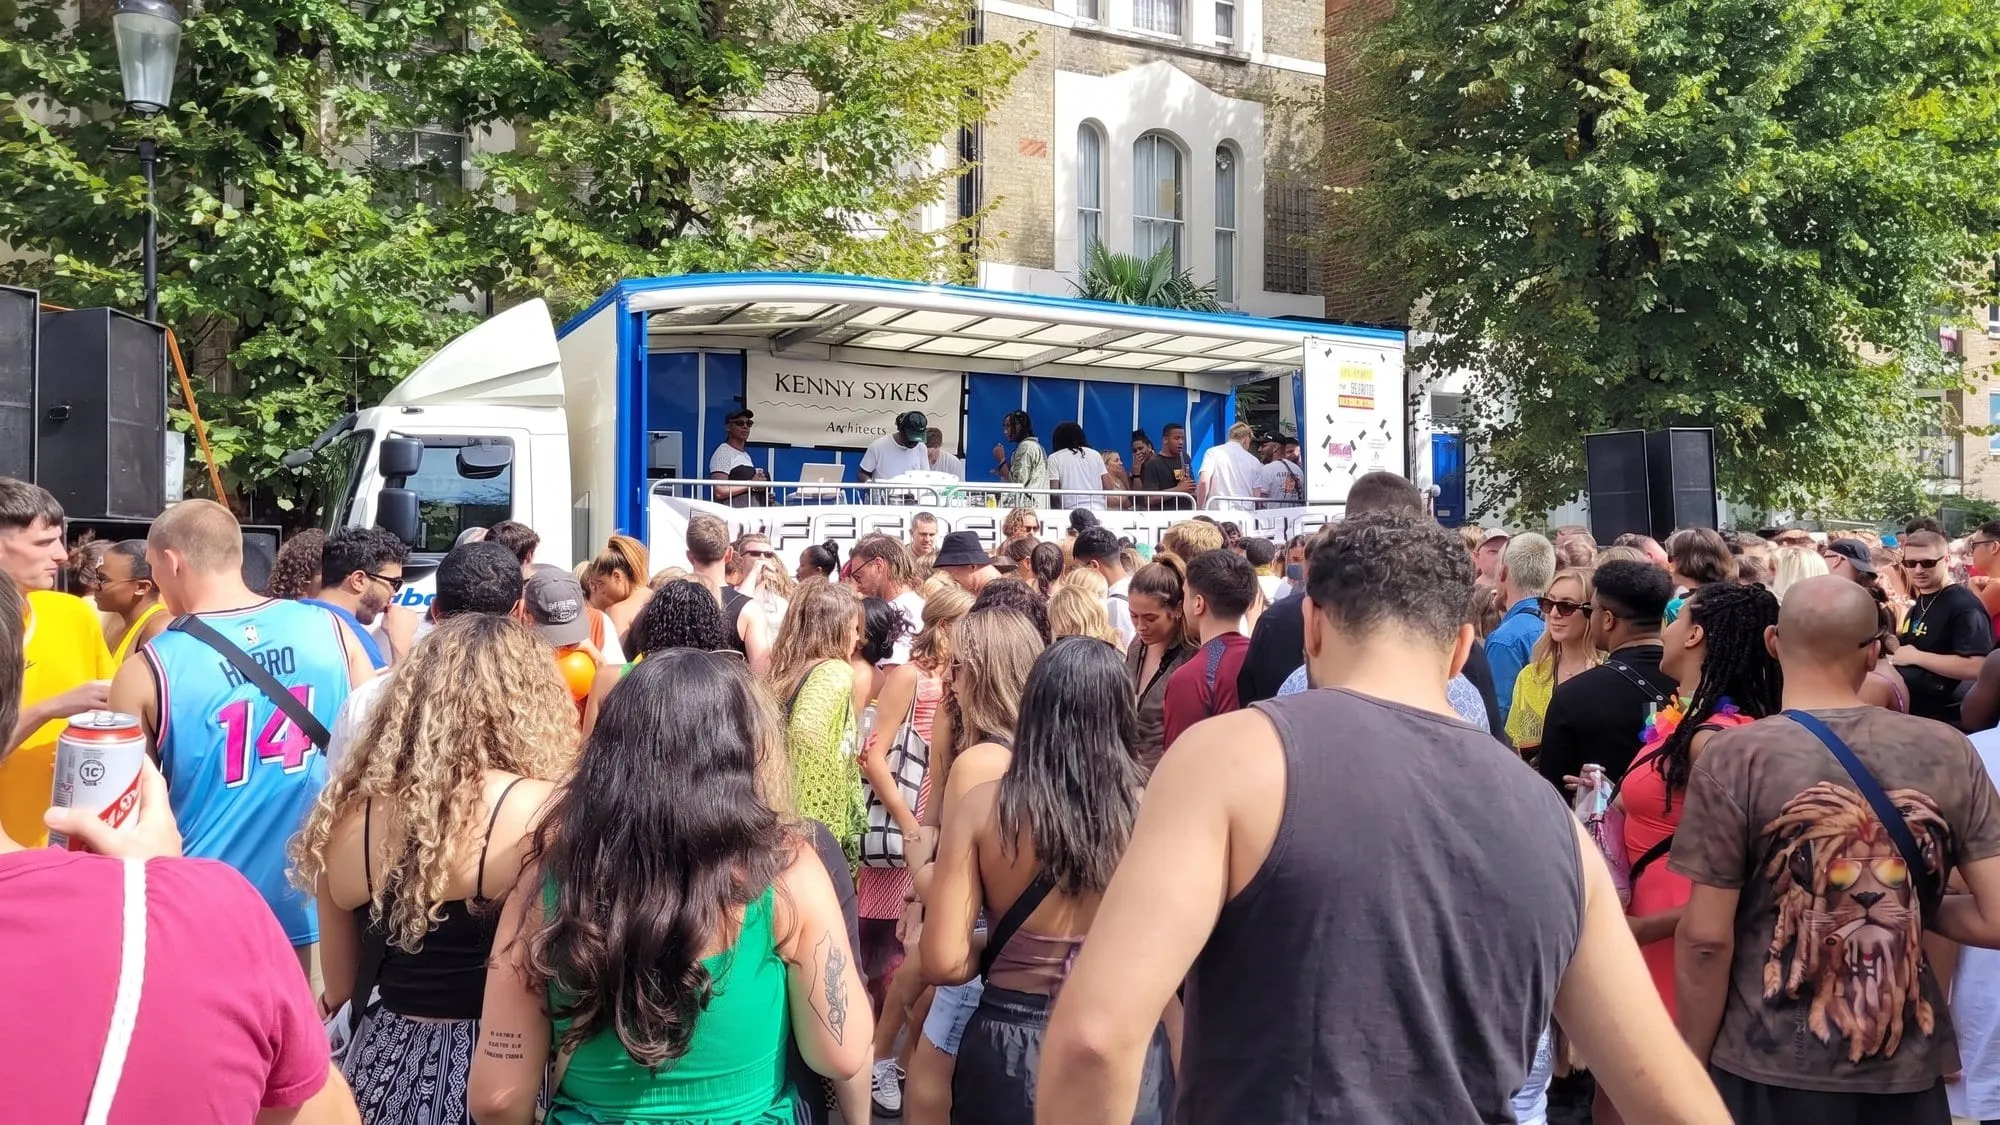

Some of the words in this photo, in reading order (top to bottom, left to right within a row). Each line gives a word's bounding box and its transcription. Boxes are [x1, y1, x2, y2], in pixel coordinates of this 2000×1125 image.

[775, 373, 855, 398] KENNY
[863, 382, 929, 402] SYKES
[826, 421, 887, 436] Architects
[218, 646, 296, 688] HRRO
[215, 683, 318, 789] 14
